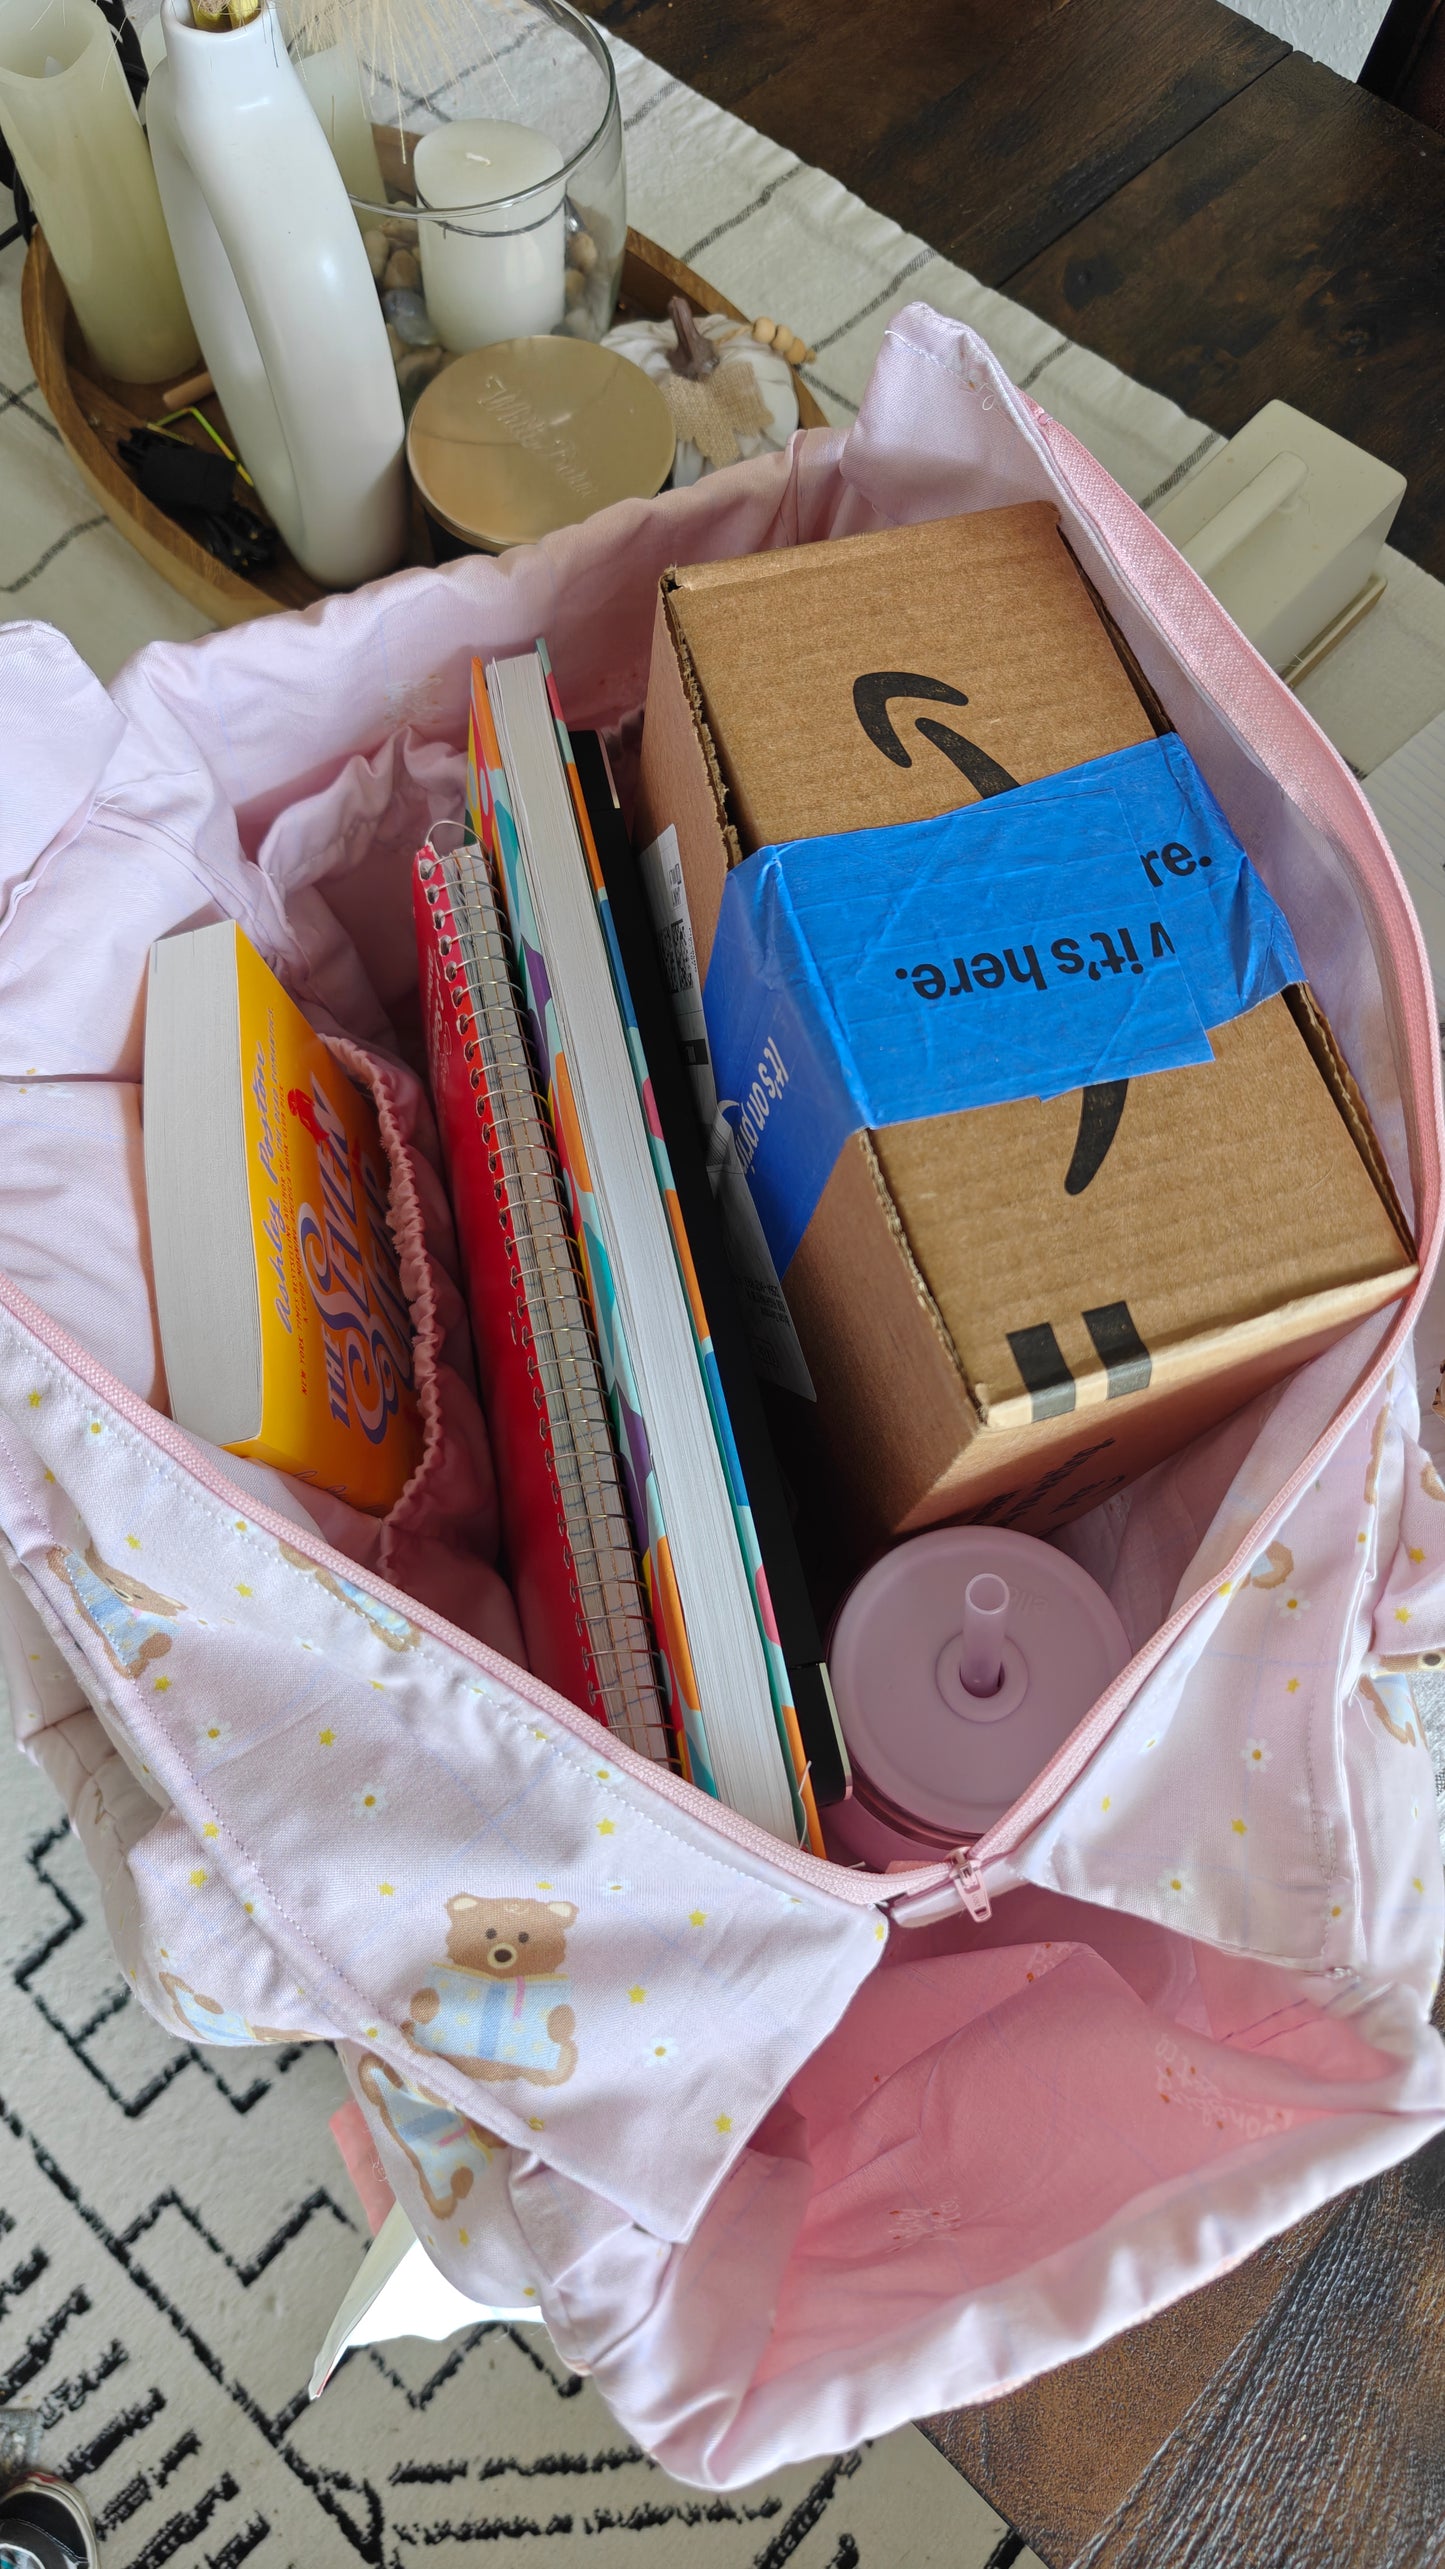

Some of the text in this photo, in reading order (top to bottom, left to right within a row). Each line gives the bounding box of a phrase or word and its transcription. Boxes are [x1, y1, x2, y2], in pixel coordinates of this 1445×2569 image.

[894, 943, 1049, 1001] here.
[1050, 927, 1145, 982] it's
[757, 1035, 790, 1100] It's
[272, 1087, 281, 1124] DEAD
[746, 1081, 771, 1132] on
[275, 1126, 283, 1154] THE
[251, 1039, 293, 1335] Ashley Poston
[280, 1175, 289, 1220] AUTHOR
[286, 1225, 300, 1295] BESTSELLING
[298, 1071, 392, 1445] SEVEN
[294, 1296, 303, 1332] TIMES
[297, 1335, 306, 1365] YORK
[320, 1324, 351, 1429] THE
[299, 1369, 308, 1396] NEW
